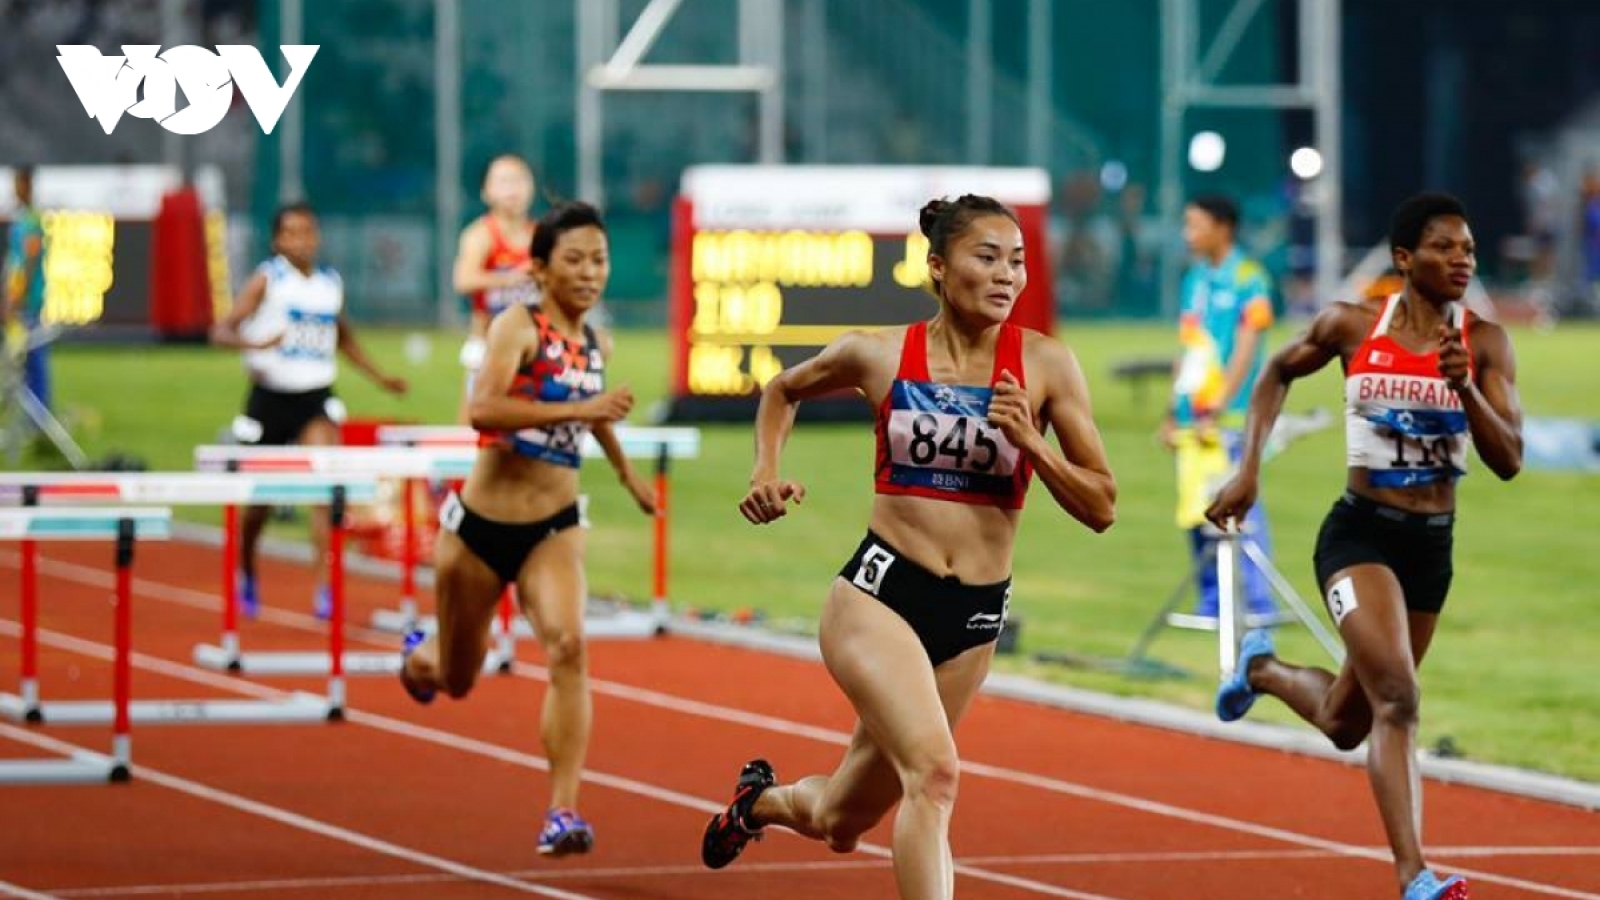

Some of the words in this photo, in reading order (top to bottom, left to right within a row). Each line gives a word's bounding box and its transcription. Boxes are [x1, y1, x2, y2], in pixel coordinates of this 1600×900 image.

[1359, 376, 1461, 412] BAHRAIN
[909, 413, 998, 472] 845
[944, 473, 969, 490] BNI
[863, 553, 888, 584] 5
[1332, 588, 1345, 618] 3
